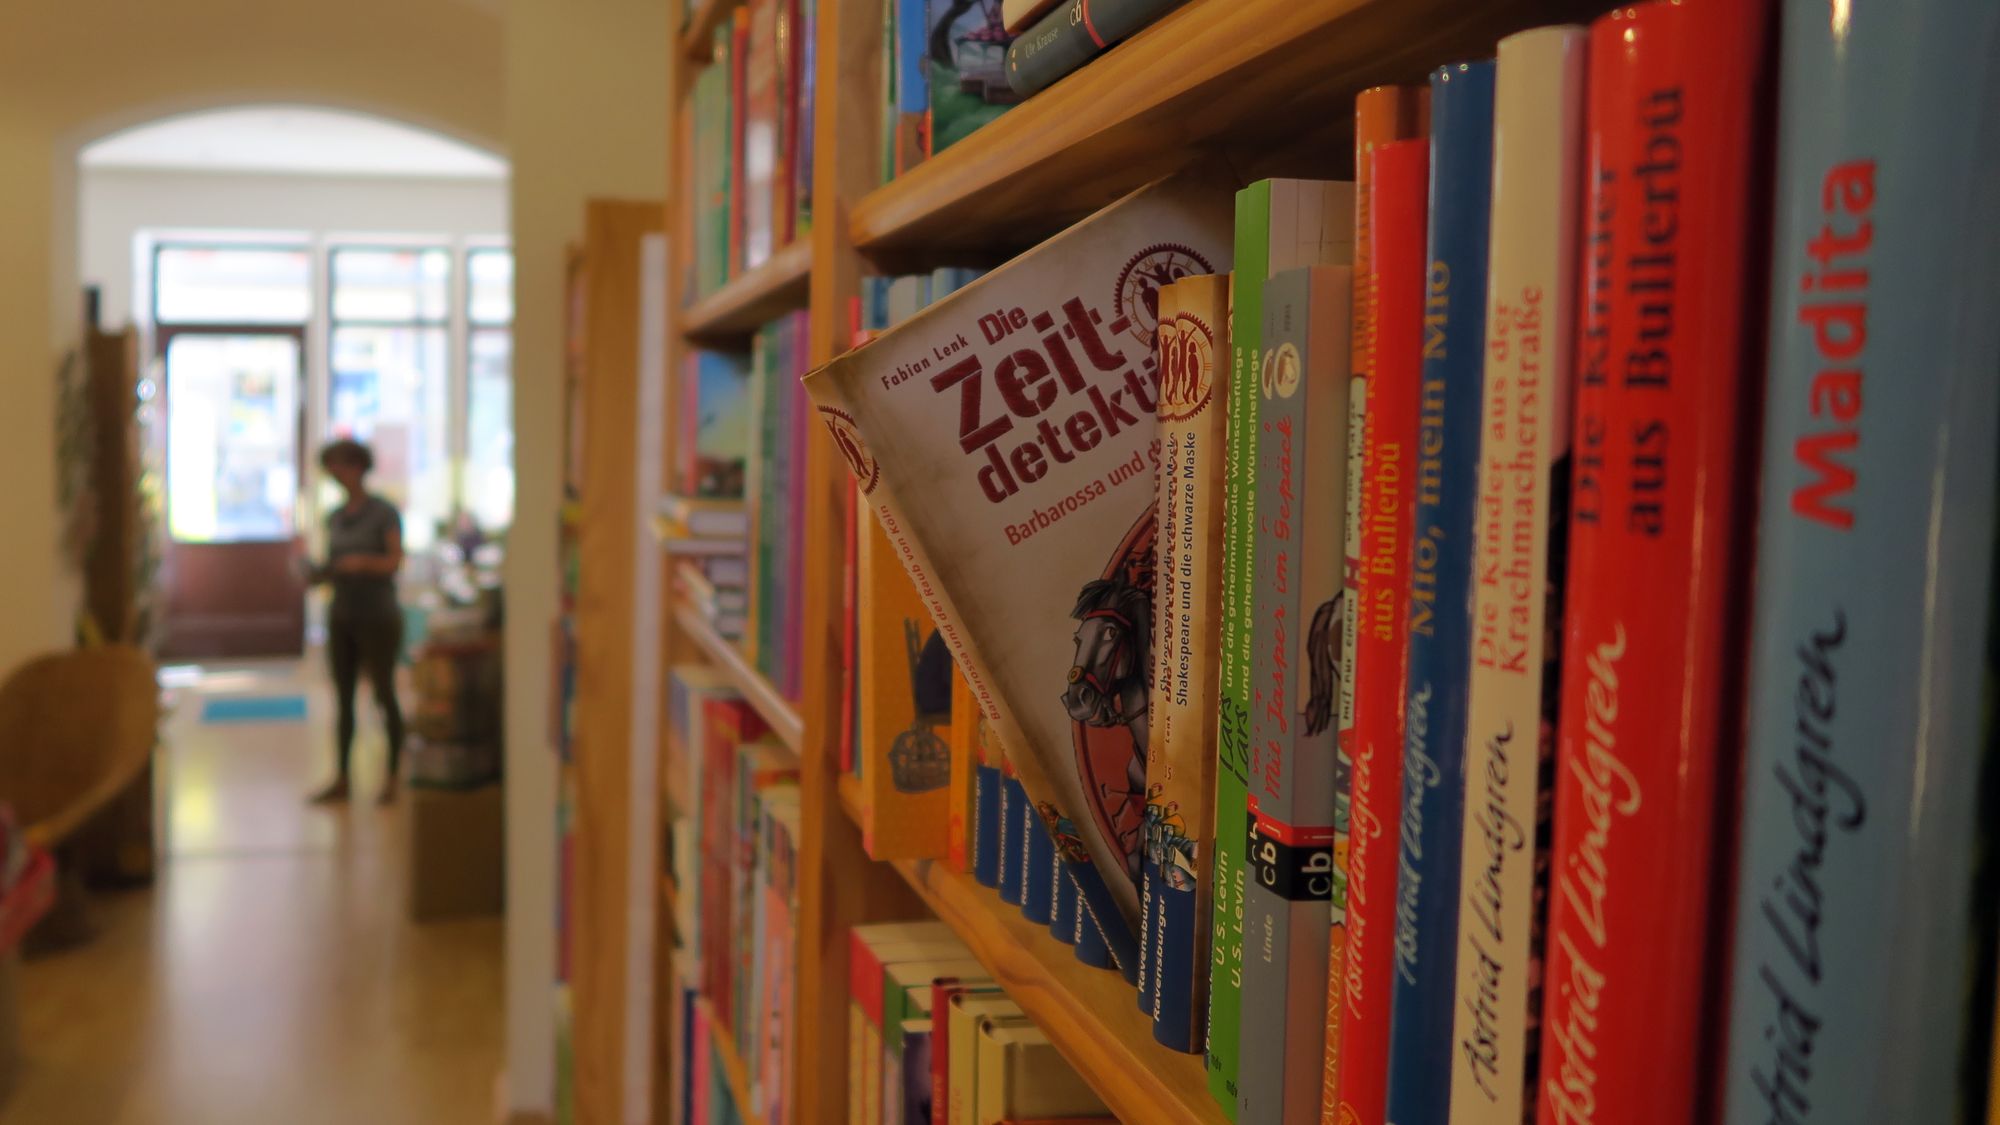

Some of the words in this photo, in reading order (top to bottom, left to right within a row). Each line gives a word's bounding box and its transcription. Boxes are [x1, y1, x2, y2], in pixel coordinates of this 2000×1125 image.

[1624, 86, 1684, 389] Bullerbü
[978, 307, 1029, 346] Die
[1423, 261, 1451, 360] Mio
[1490, 304, 1509, 362] der
[1790, 157, 1878, 533] Madita
[881, 356, 931, 390] Fabian
[933, 333, 969, 362] Lenk
[929, 296, 1132, 455] Zeit-
[1231, 346, 1244, 478] Wünschefliege
[1247, 349, 1260, 485] Wünschefliege
[1419, 378, 1447, 506] mein
[1491, 377, 1506, 441] aus
[1004, 480, 1107, 546] Barbarossa
[1108, 450, 1145, 487] und
[1183, 431, 1195, 479] Maske
[1274, 416, 1296, 541] Gepäck
[1501, 286, 1542, 676] Krachmacherstraße
[1575, 416, 1603, 524] Die
[1627, 420, 1667, 537] aus
[880, 504, 900, 535] Köln
[898, 537, 915, 562] von
[1182, 483, 1194, 550] schwarze
[1228, 483, 1239, 618] geheimnisvolle
[1370, 441, 1401, 577] Bullerbü
[1481, 458, 1504, 586] Kinder
[912, 563, 934, 597] Raub
[1180, 580, 1191, 610] und
[1181, 554, 1192, 577] die
[1244, 490, 1256, 629] geheimnisvolle
[1273, 551, 1287, 593] im
[1410, 525, 1447, 638] Mio,
[932, 599, 947, 621] der
[943, 623, 962, 649] und
[1227, 622, 1235, 649] die
[1242, 633, 1251, 661] die
[1374, 587, 1395, 642] aus
[1478, 601, 1498, 668] Die
[960, 651, 1001, 721] Barbarossa
[1177, 613, 1192, 706] Shakespeare
[1266, 604, 1288, 735] Jasper
[1219, 691, 1233, 772] Lars
[1235, 704, 1248, 787] Lars
[1265, 740, 1281, 799] Mit
[1400, 681, 1441, 861] Lindgren
[1347, 742, 1382, 906] Lindgren
[1560, 616, 1641, 948] Lindgren
[1761, 609, 1866, 986] Lindgren
[1022, 804, 1032, 905] Ravensburger
[1469, 719, 1524, 943] Lindgren
[1217, 850, 1228, 913] Levin
[1233, 869, 1245, 934] Levin
[1394, 850, 1423, 986] Astrid
[1138, 872, 1151, 993] Ravensburger
[1153, 895, 1167, 1023] Ravensburger
[1216, 946, 1225, 966] U.
[1217, 921, 1226, 940] S.
[1232, 943, 1242, 962] S.
[1263, 914, 1273, 963] Linde
[1232, 967, 1242, 988] U.
[1463, 934, 1505, 1103] Astrid
